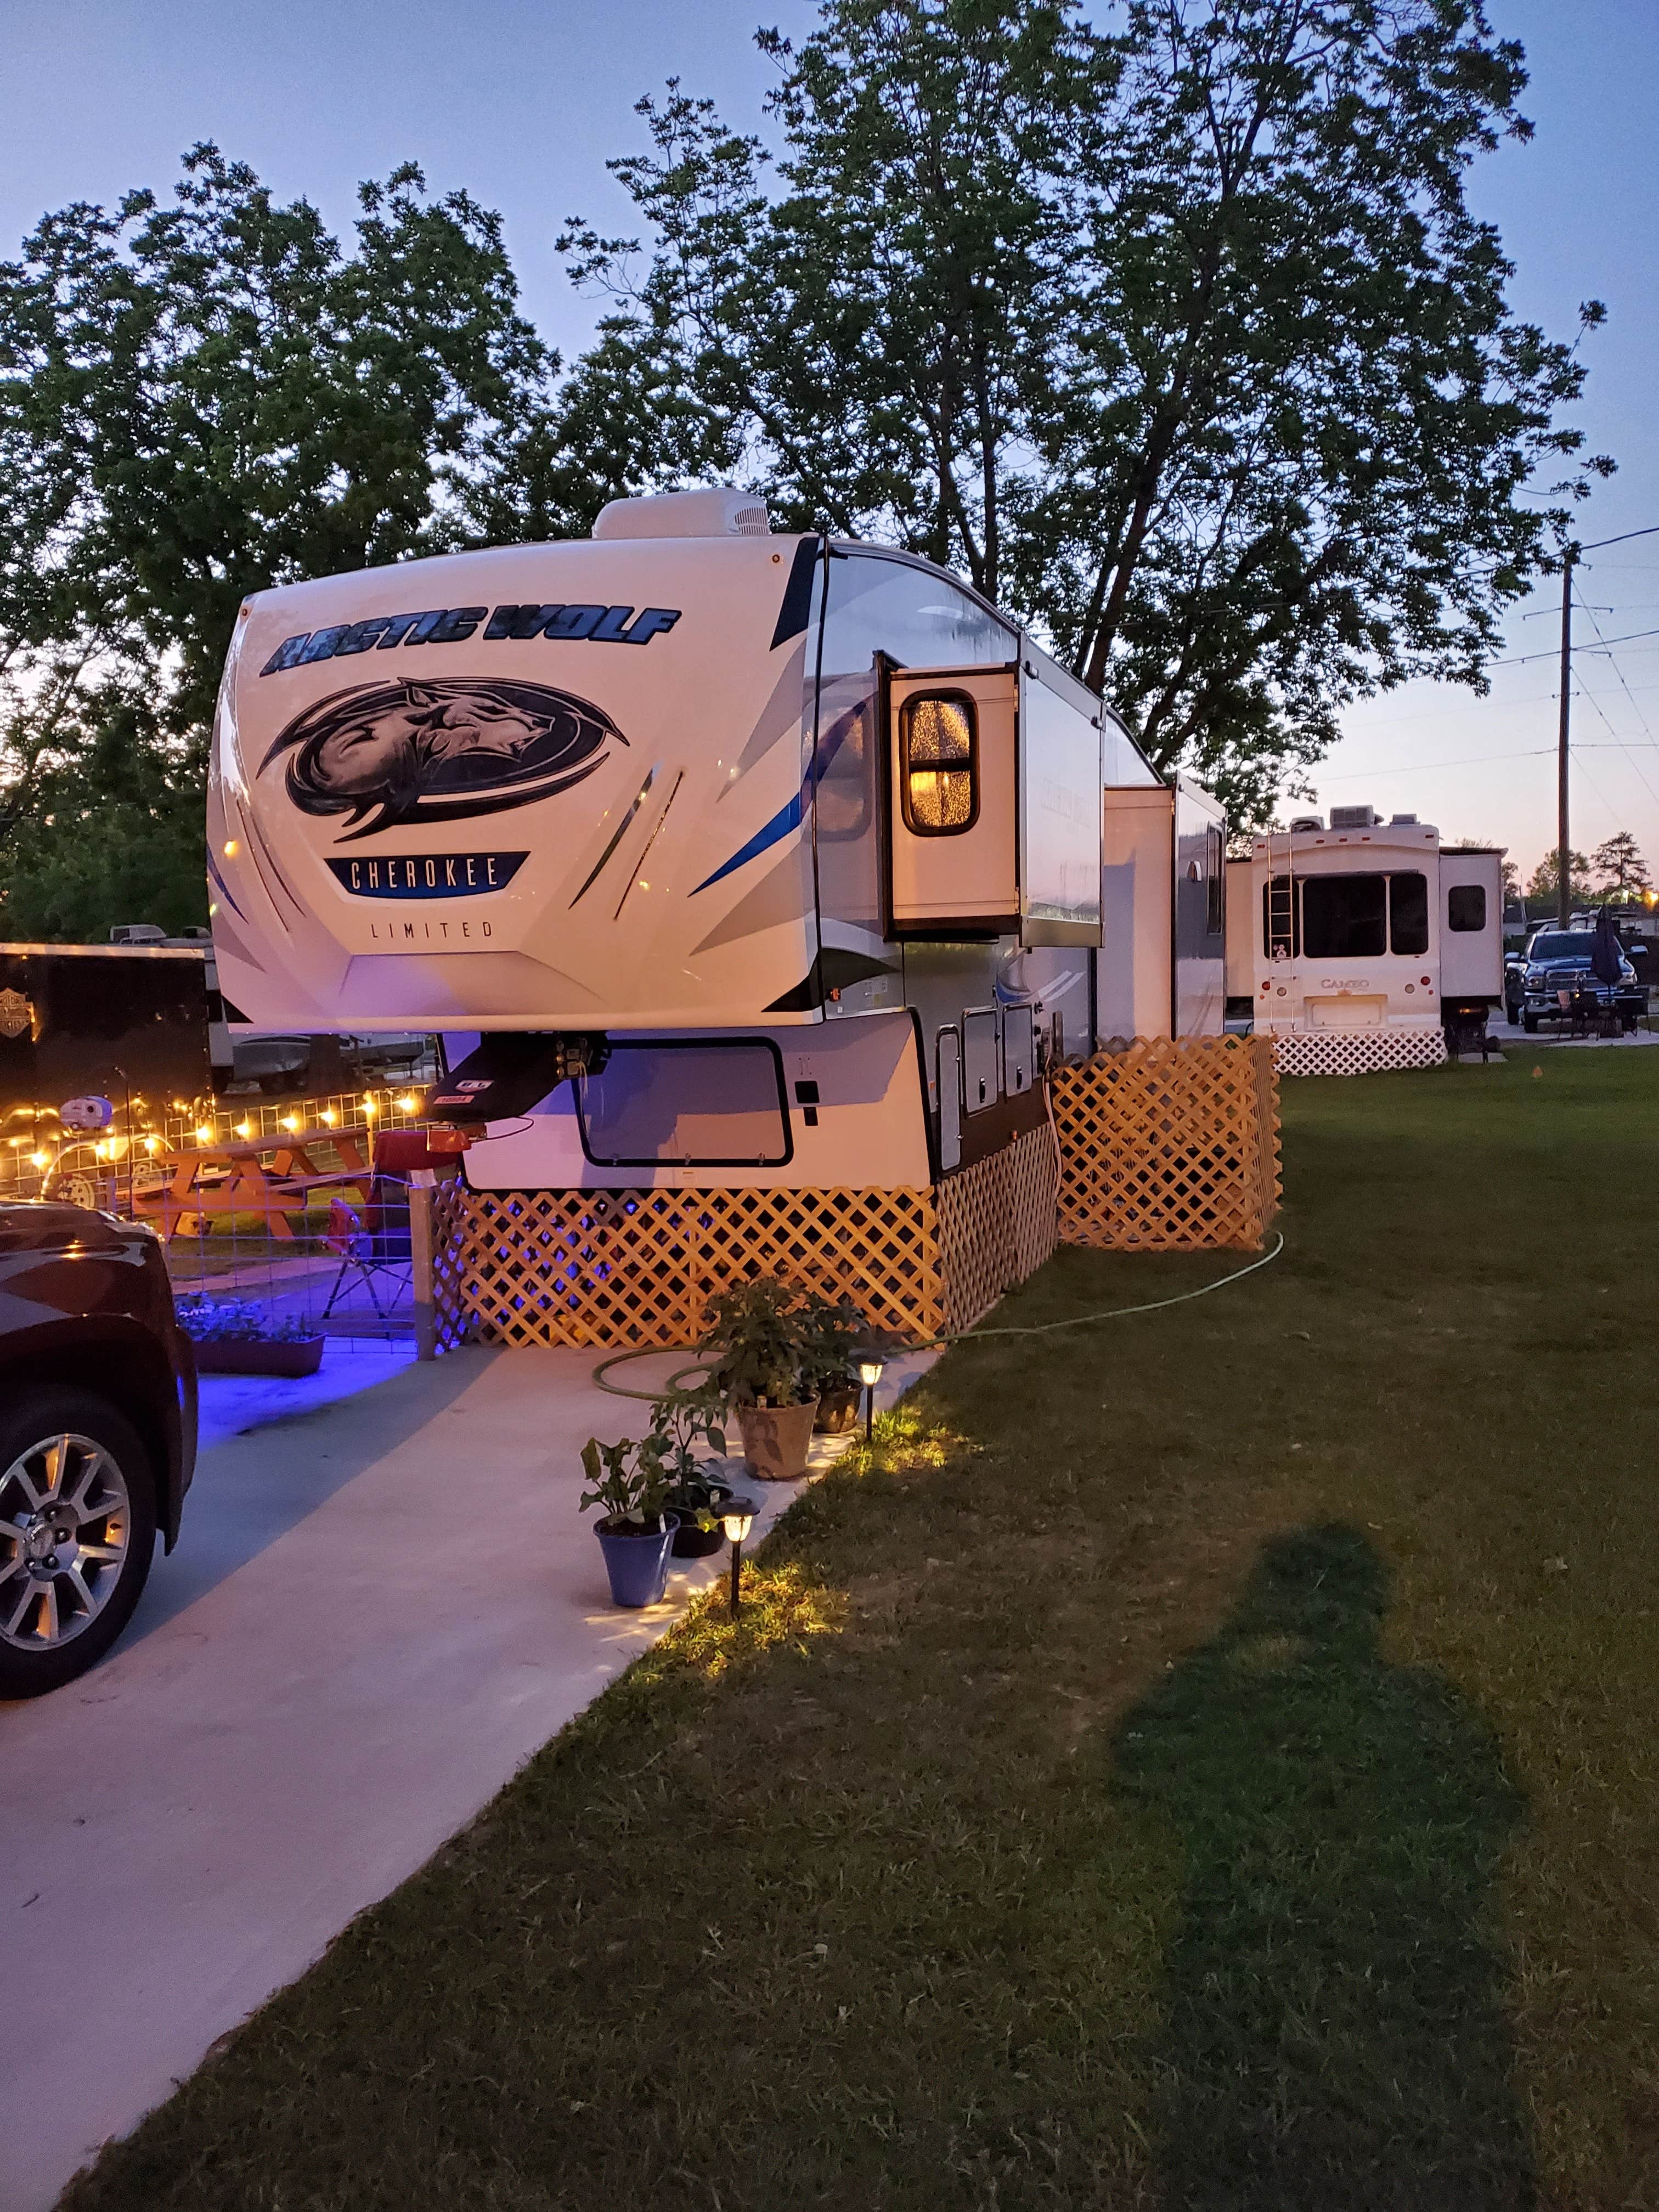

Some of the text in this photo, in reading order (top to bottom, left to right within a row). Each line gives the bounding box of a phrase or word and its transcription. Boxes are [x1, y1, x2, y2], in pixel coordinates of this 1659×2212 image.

[259, 605, 682, 677] ARCTIC WOLF
[352, 857, 498, 889] CHEROKEE
[371, 922, 492, 938] LIMITED
